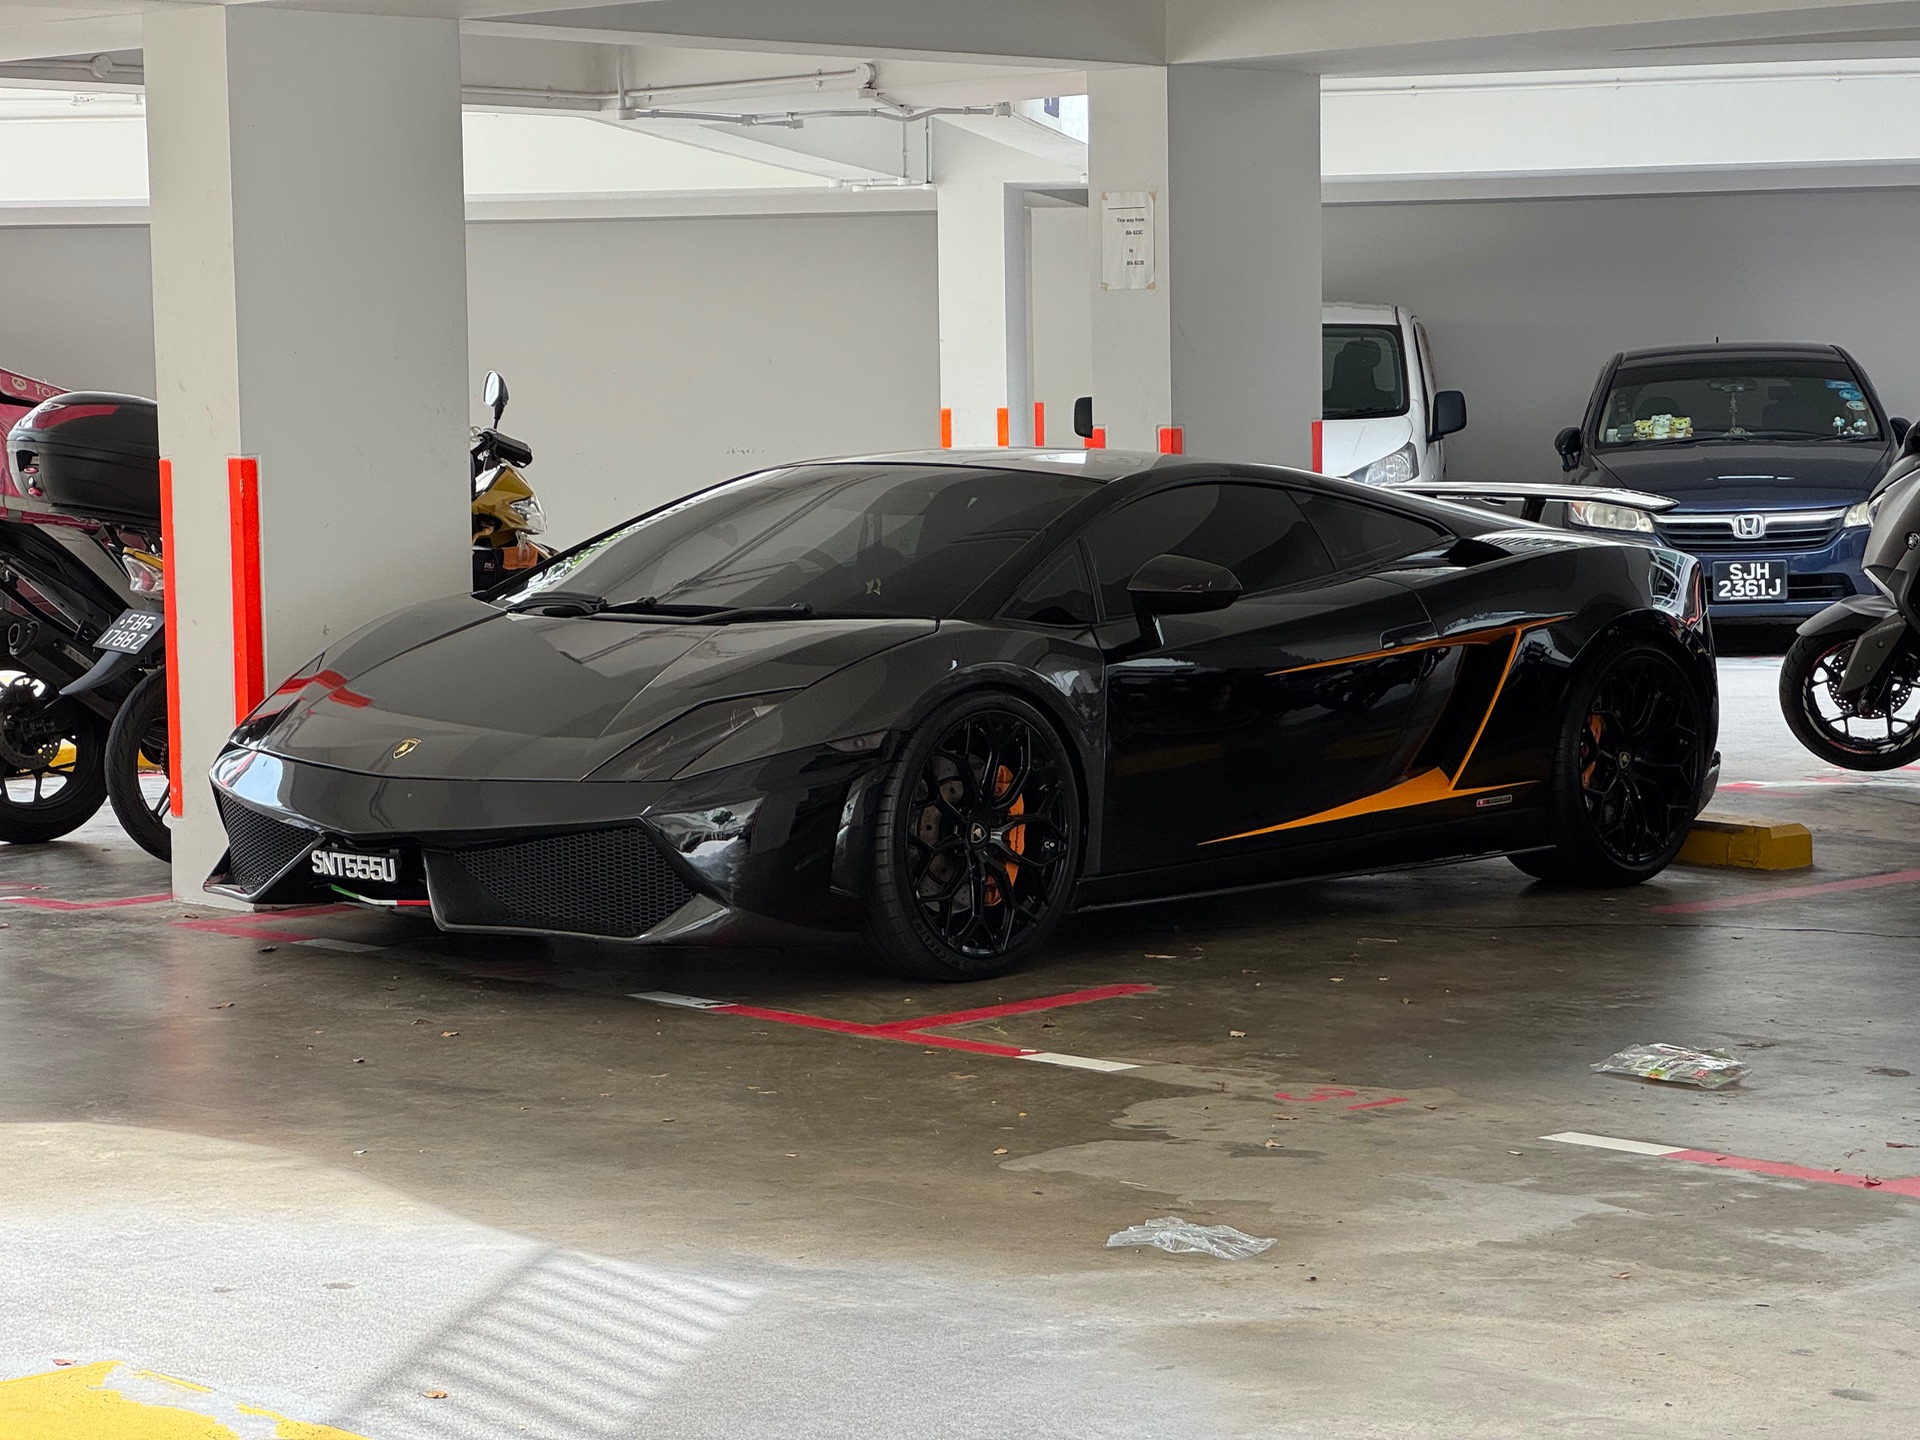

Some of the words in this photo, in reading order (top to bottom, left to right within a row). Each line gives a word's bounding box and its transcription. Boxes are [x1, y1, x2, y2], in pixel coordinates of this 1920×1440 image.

[1729, 562, 1770, 580] SJH
[1718, 578, 1781, 597] 2361J
[121, 613, 156, 631] FBF
[99, 629, 148, 650] 1788Z
[311, 850, 396, 882] SNT555U
